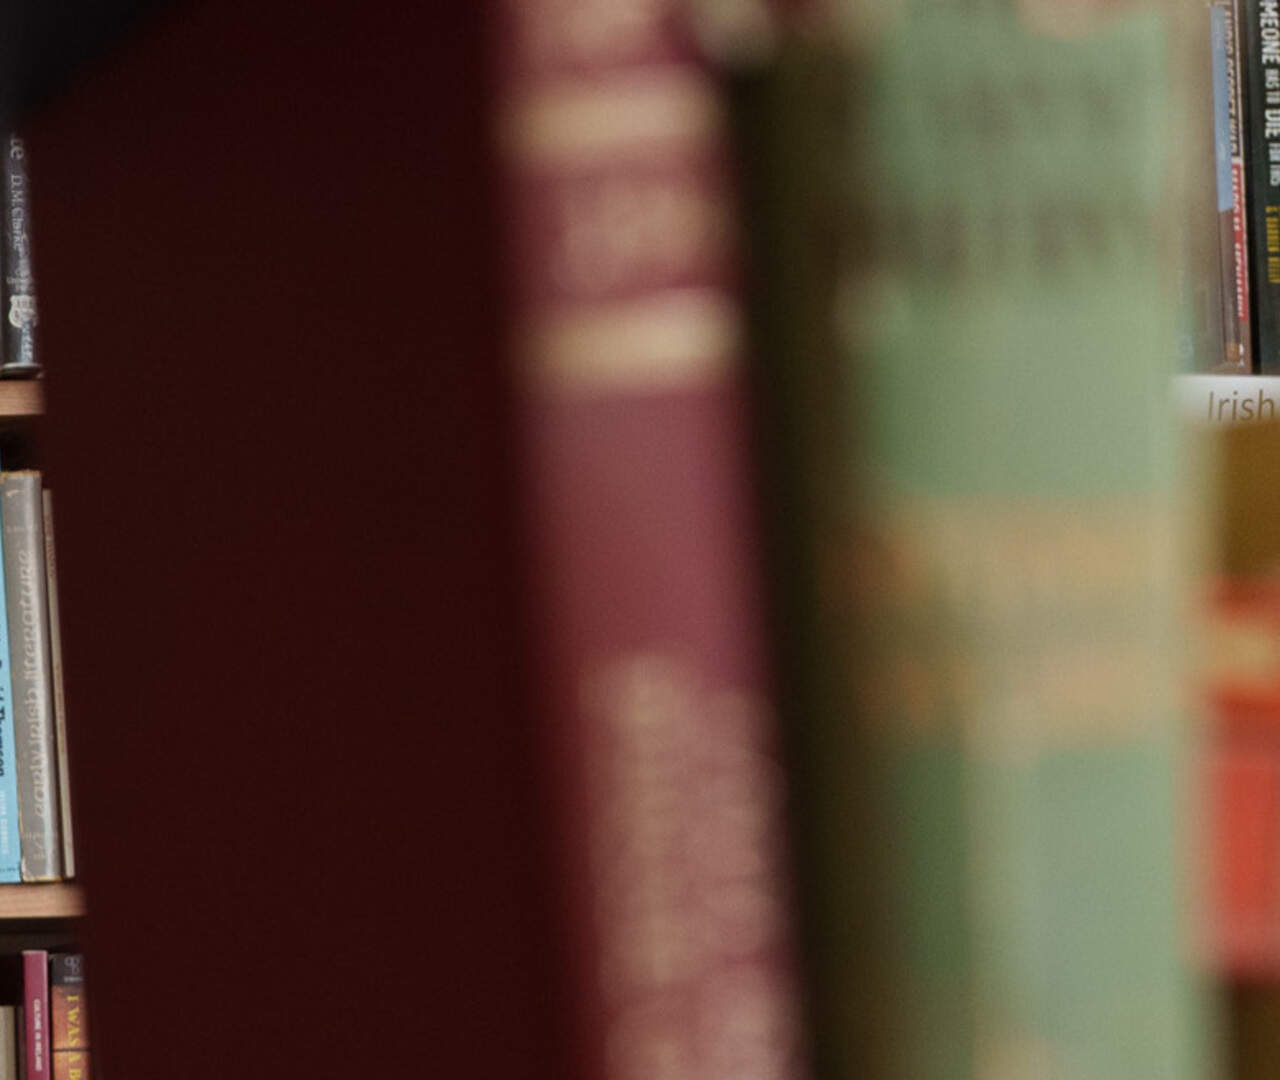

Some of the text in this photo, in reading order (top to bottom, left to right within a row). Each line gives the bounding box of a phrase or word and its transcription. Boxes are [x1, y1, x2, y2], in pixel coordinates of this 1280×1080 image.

[1264, 107, 1280, 137] DIE
[1208, 388, 1276, 422] Irish
[66, 1005, 82, 1046] WAS
[68, 1051, 83, 1063] A
